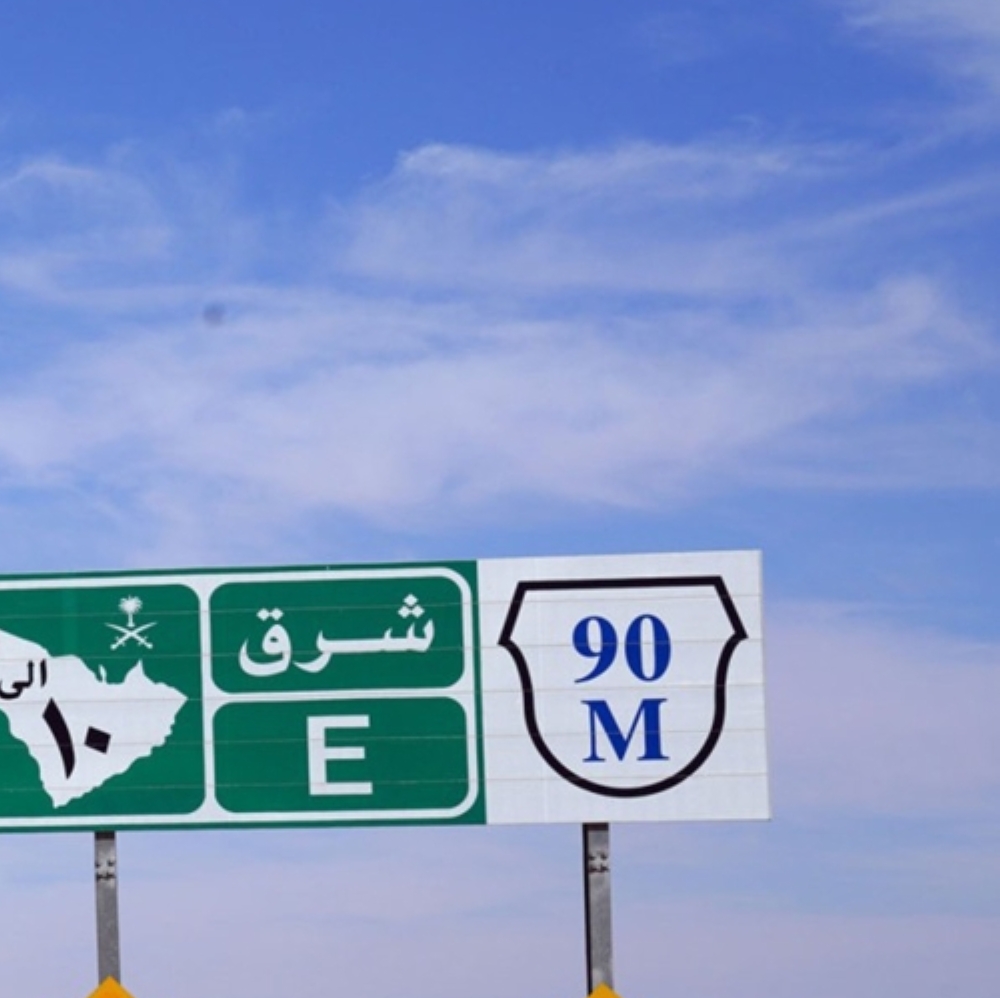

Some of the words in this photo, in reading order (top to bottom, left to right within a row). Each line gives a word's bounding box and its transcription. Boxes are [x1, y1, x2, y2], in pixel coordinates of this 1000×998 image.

[238, 593, 435, 677] شرق
[572, 613, 672, 684] 90
[41, 697, 112, 780] ١٠
[306, 714, 373, 796] E
[580, 698, 670, 763] M
